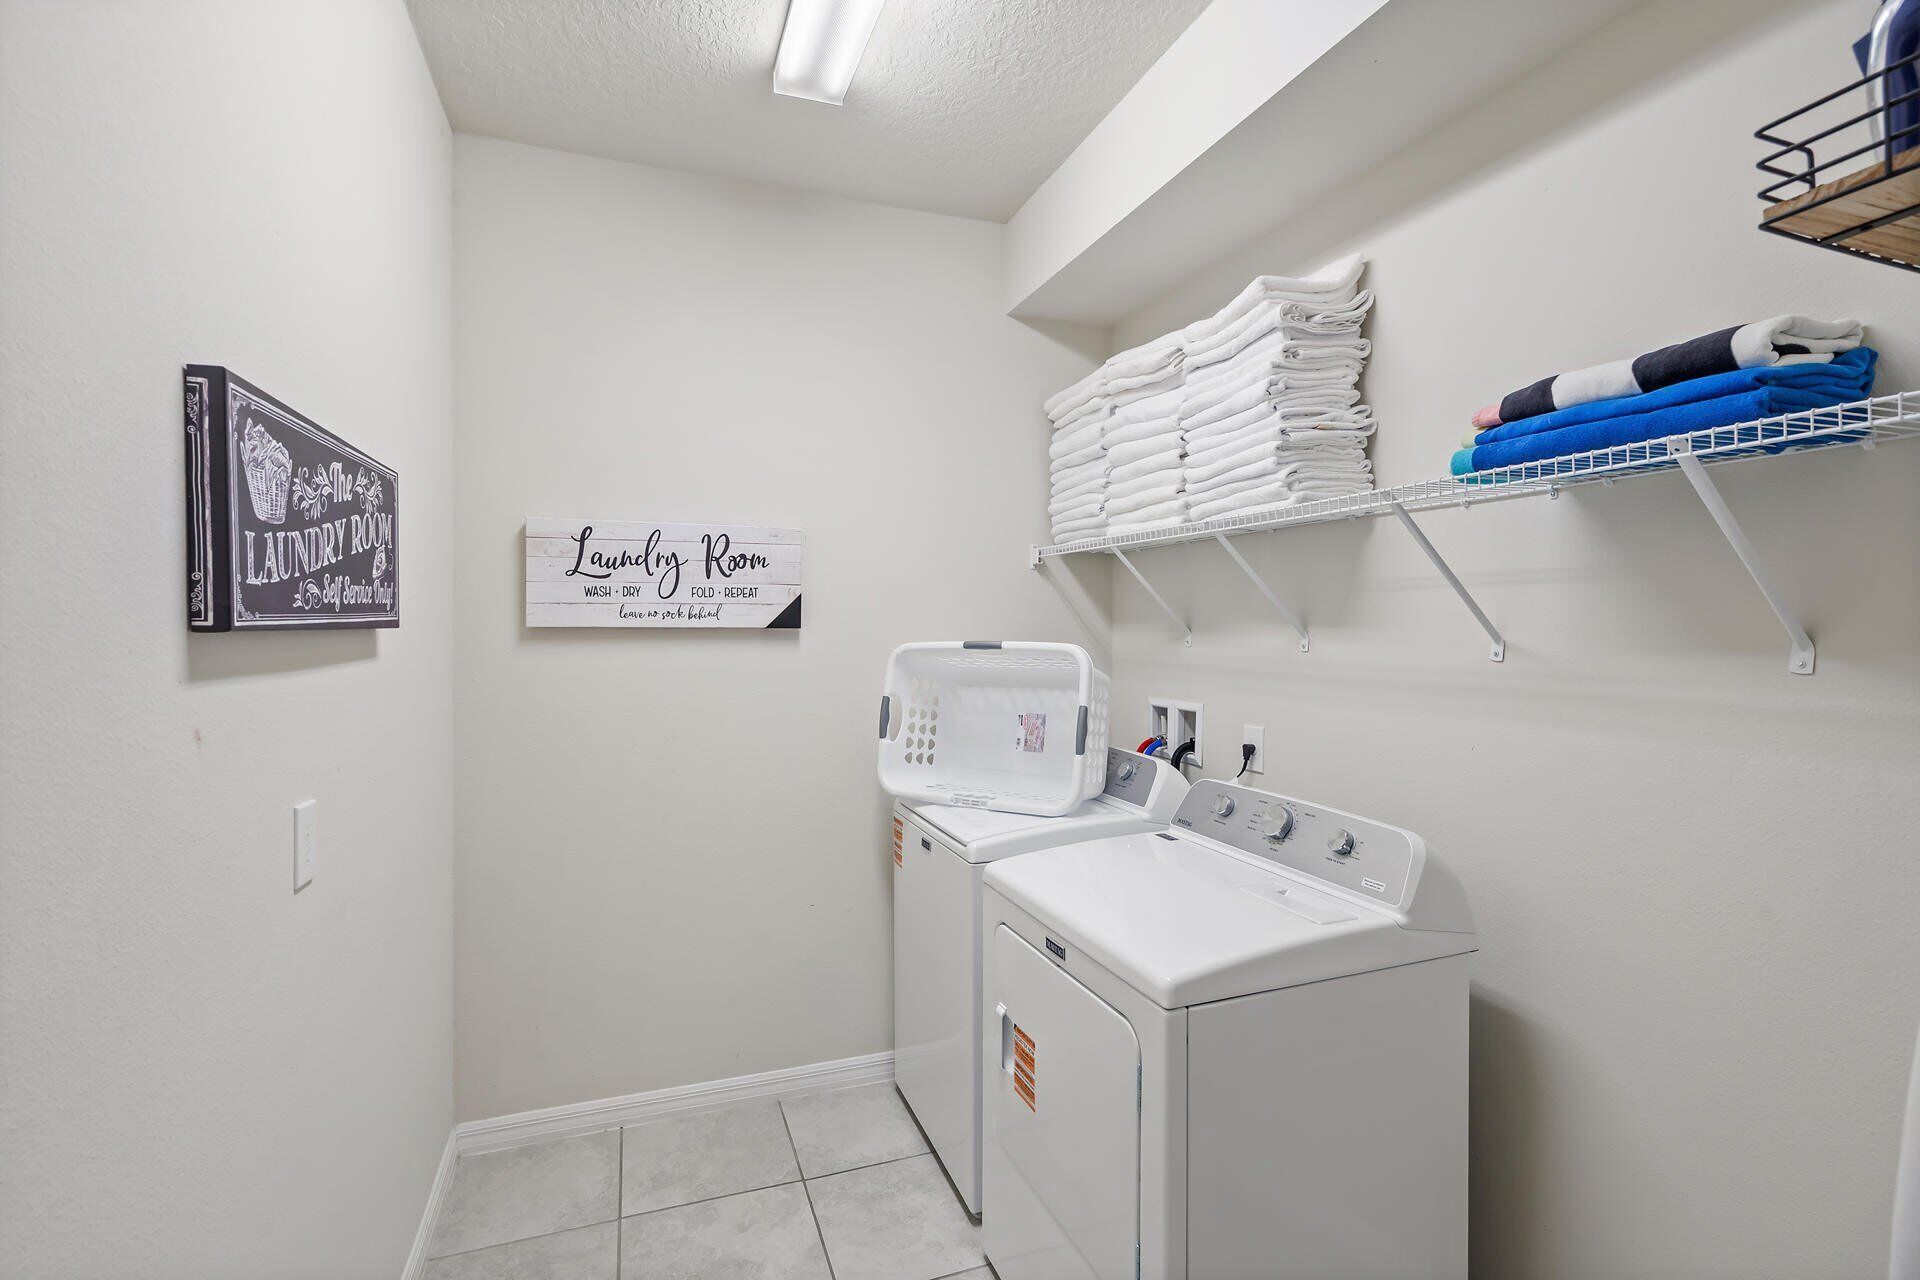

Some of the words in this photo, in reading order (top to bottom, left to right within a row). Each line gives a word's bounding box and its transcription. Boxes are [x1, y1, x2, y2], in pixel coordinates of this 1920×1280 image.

[329, 461, 353, 503] The
[245, 518, 347, 586] LAUNDRY
[350, 512, 393, 554] ROOM
[565, 525, 689, 600] Laundry
[701, 533, 770, 580] Room
[322, 573, 344, 612] Self
[343, 575, 373, 605] Service
[373, 579, 394, 611] Only!
[583, 585, 612, 598] WASH
[622, 585, 642, 598] DRY
[691, 586, 715, 599] FOLD
[724, 586, 759, 599] REPEAT
[619, 603, 646, 619] leave
[647, 610, 660, 618] no
[661, 604, 686, 620] sock
[687, 602, 723, 621] behind
